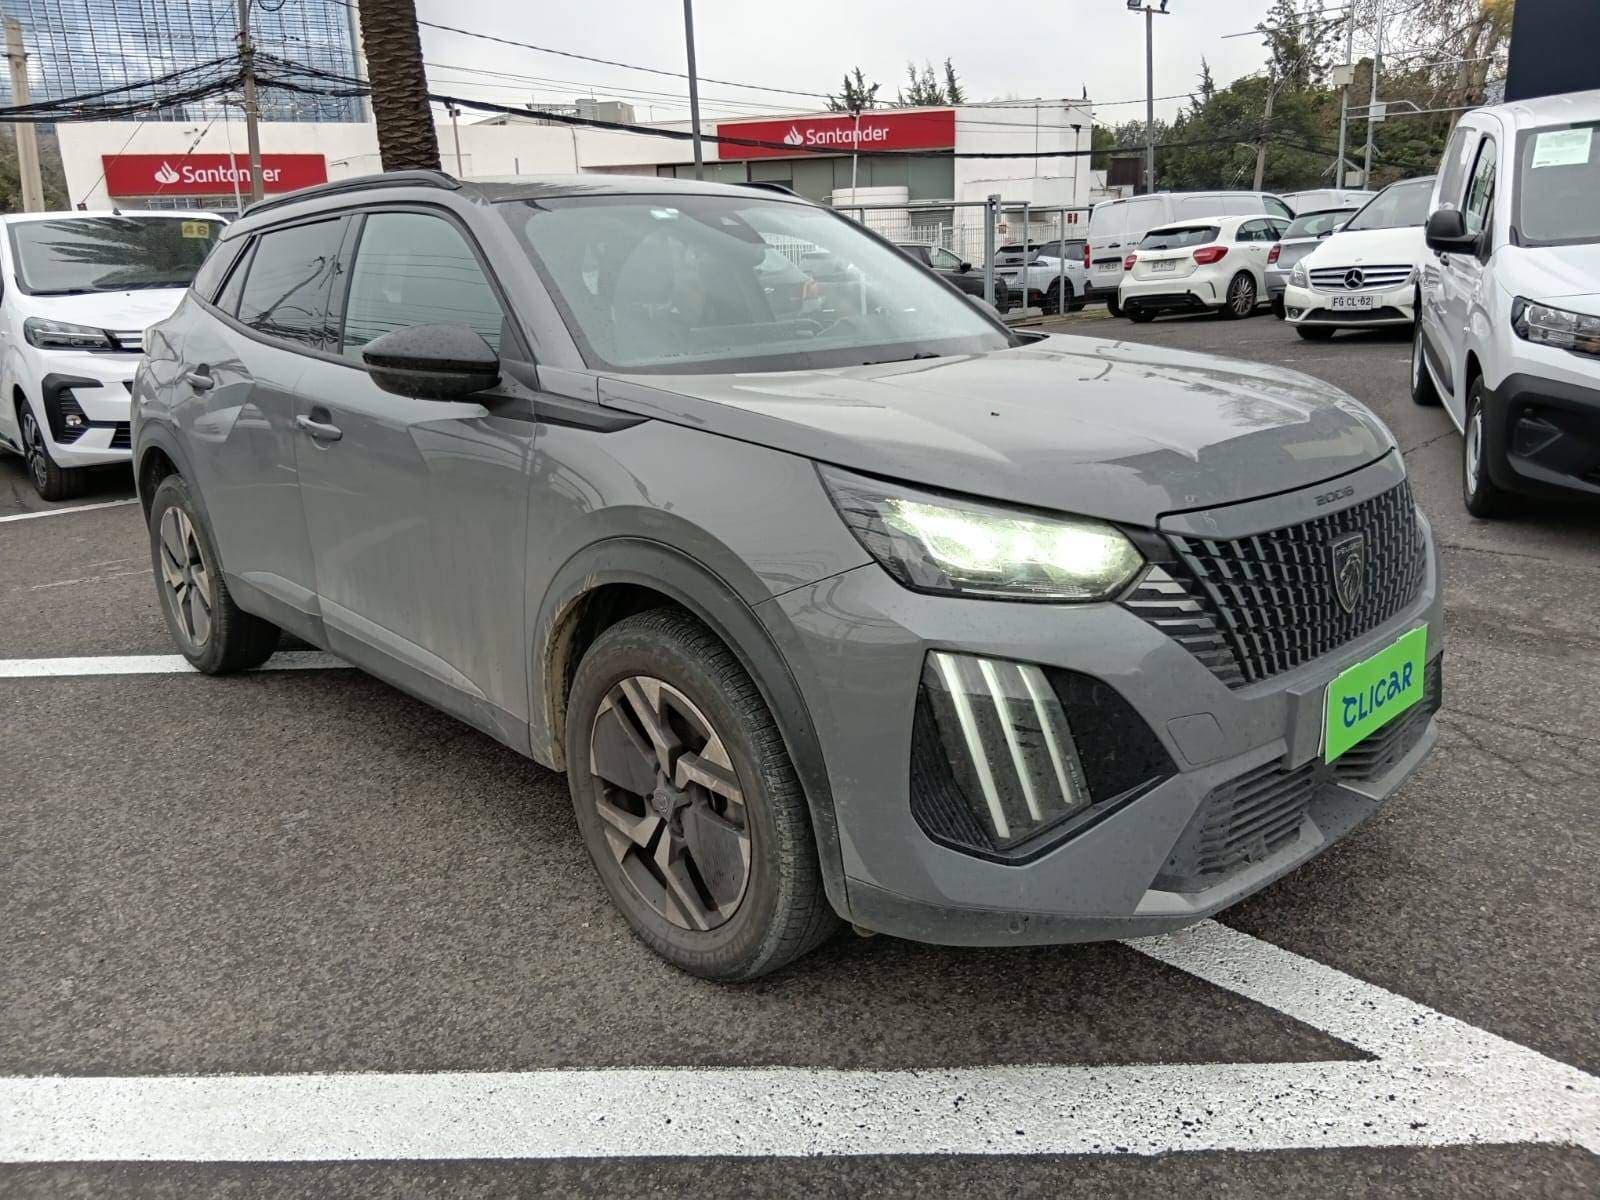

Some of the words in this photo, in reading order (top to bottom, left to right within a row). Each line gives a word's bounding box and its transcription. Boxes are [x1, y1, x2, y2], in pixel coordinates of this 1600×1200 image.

[805, 126, 889, 145] Santander
[182, 164, 282, 184] Santaner
[1333, 297, 1344, 307] FG
